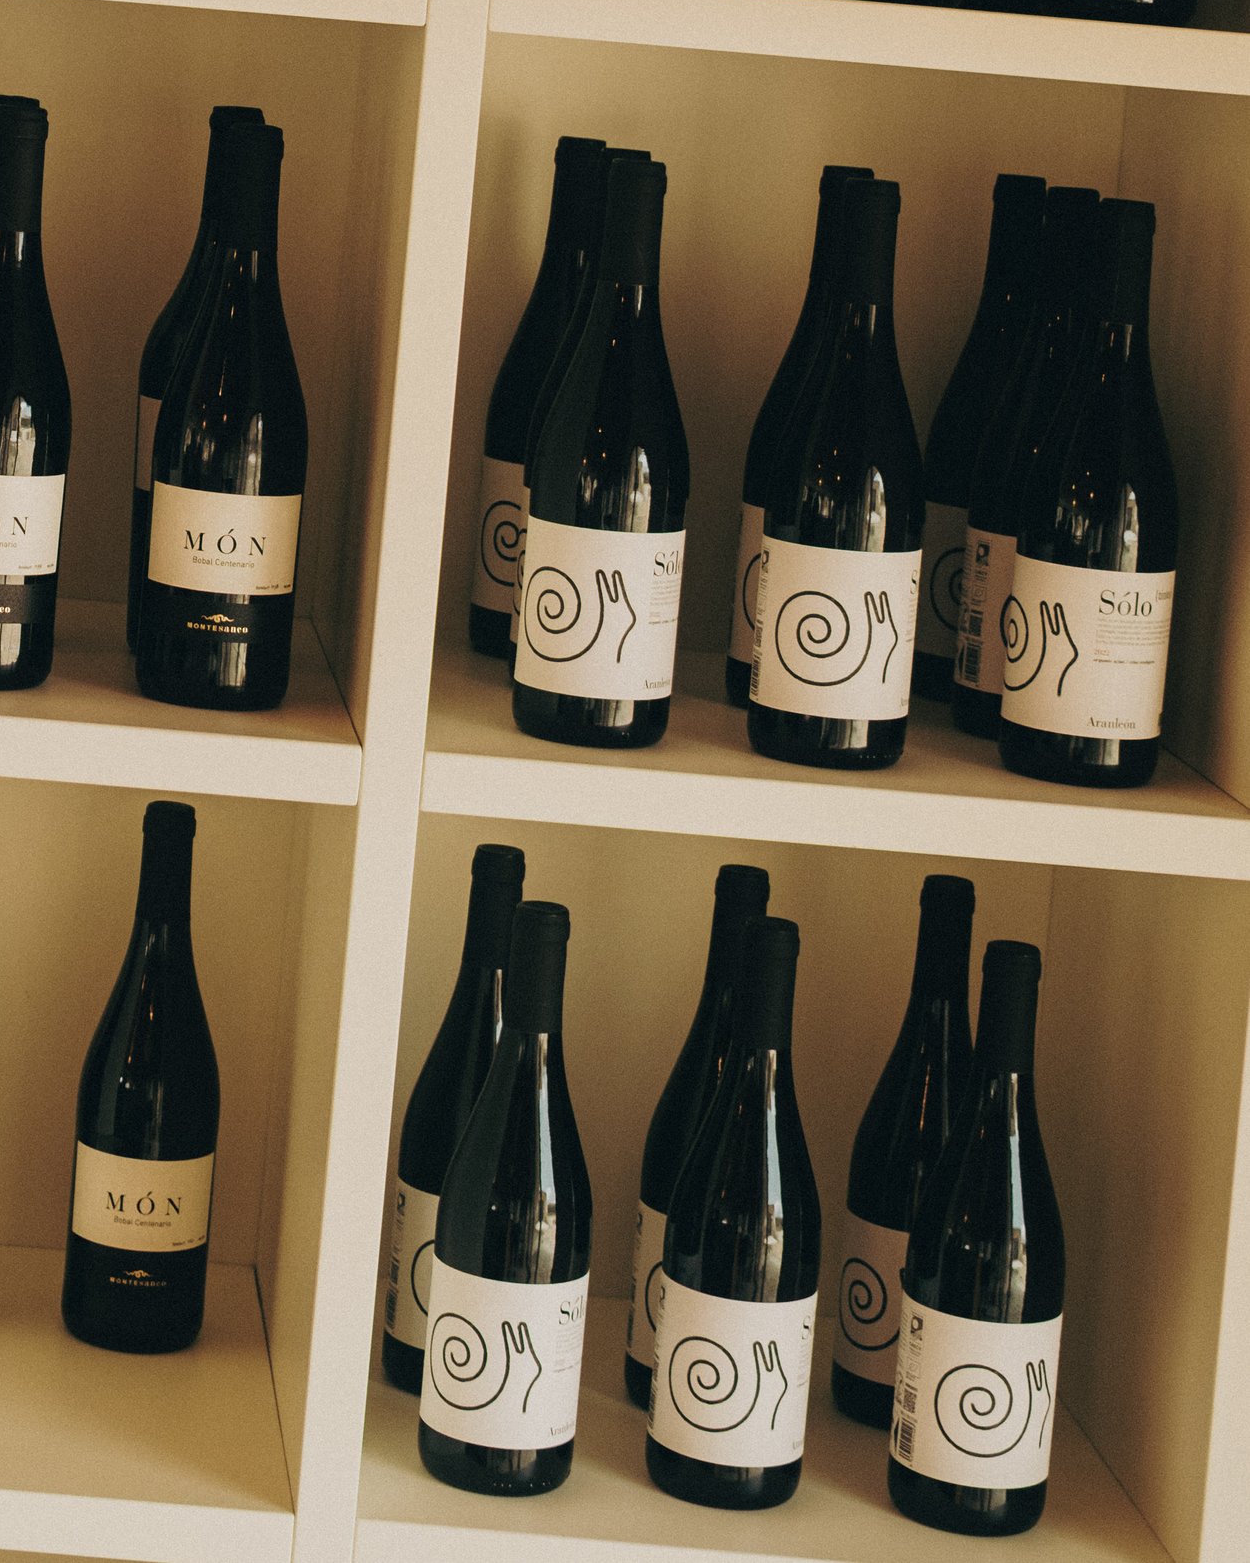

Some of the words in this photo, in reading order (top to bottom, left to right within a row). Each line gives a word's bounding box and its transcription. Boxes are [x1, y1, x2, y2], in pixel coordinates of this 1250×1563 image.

[183, 528, 267, 557] MÓN
[191, 555, 213, 567] Bobal
[214, 557, 256, 570] Centenario
[1098, 589, 1153, 617] Sólo
[105, 1190, 182, 1217] MÓN
